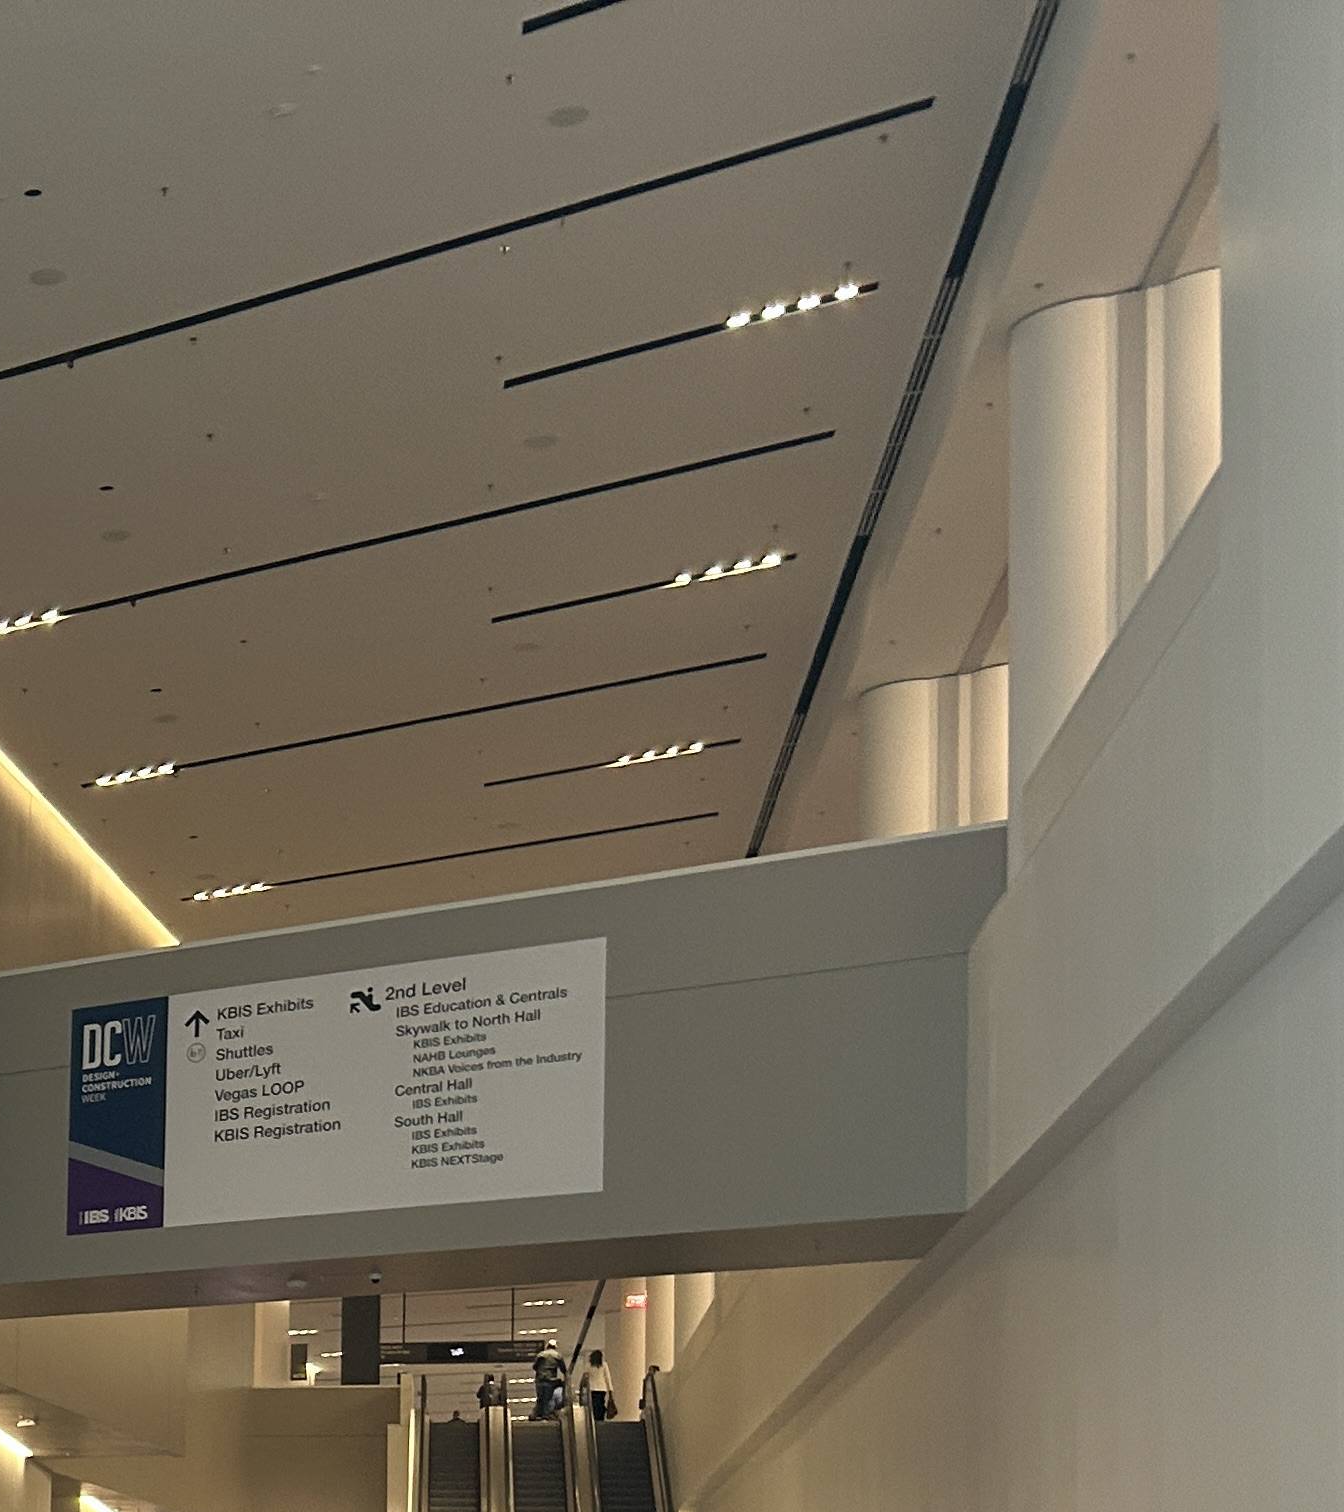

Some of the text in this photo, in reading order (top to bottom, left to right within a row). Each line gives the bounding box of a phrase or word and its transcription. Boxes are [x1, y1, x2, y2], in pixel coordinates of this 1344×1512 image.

[385, 977, 467, 1001] 2nd Level
[216, 998, 314, 1021] KBIS Exhibits
[396, 986, 568, 1018] IBS Education & Centrals
[395, 1009, 541, 1038] Skywalk to North Hall
[82, 1014, 156, 1070] DCW
[216, 1025, 244, 1041] Taxi
[413, 1032, 487, 1050] KBIS Exhibits
[216, 1044, 274, 1061] Shuttles
[413, 1046, 496, 1064] NAHB Lounges
[215, 1062, 282, 1081] Uber/Lyft
[413, 1051, 583, 1078] NKBA Voices from the Industry
[81, 1076, 152, 1093] CONSTRUCTION
[214, 1080, 305, 1103] Vegas LOOP
[394, 1077, 472, 1097] Central Hall
[214, 1100, 331, 1122] IBS Registration
[412, 1095, 478, 1109] IBS Exhibits
[394, 1110, 463, 1128] South Hall
[214, 1120, 341, 1143] KBIS Registration
[412, 1126, 477, 1141] IBS Exhibits
[412, 1140, 485, 1155] KBIS Exhibits
[411, 1157, 439, 1169] KBIS
[84, 1209, 109, 1225] IBS
